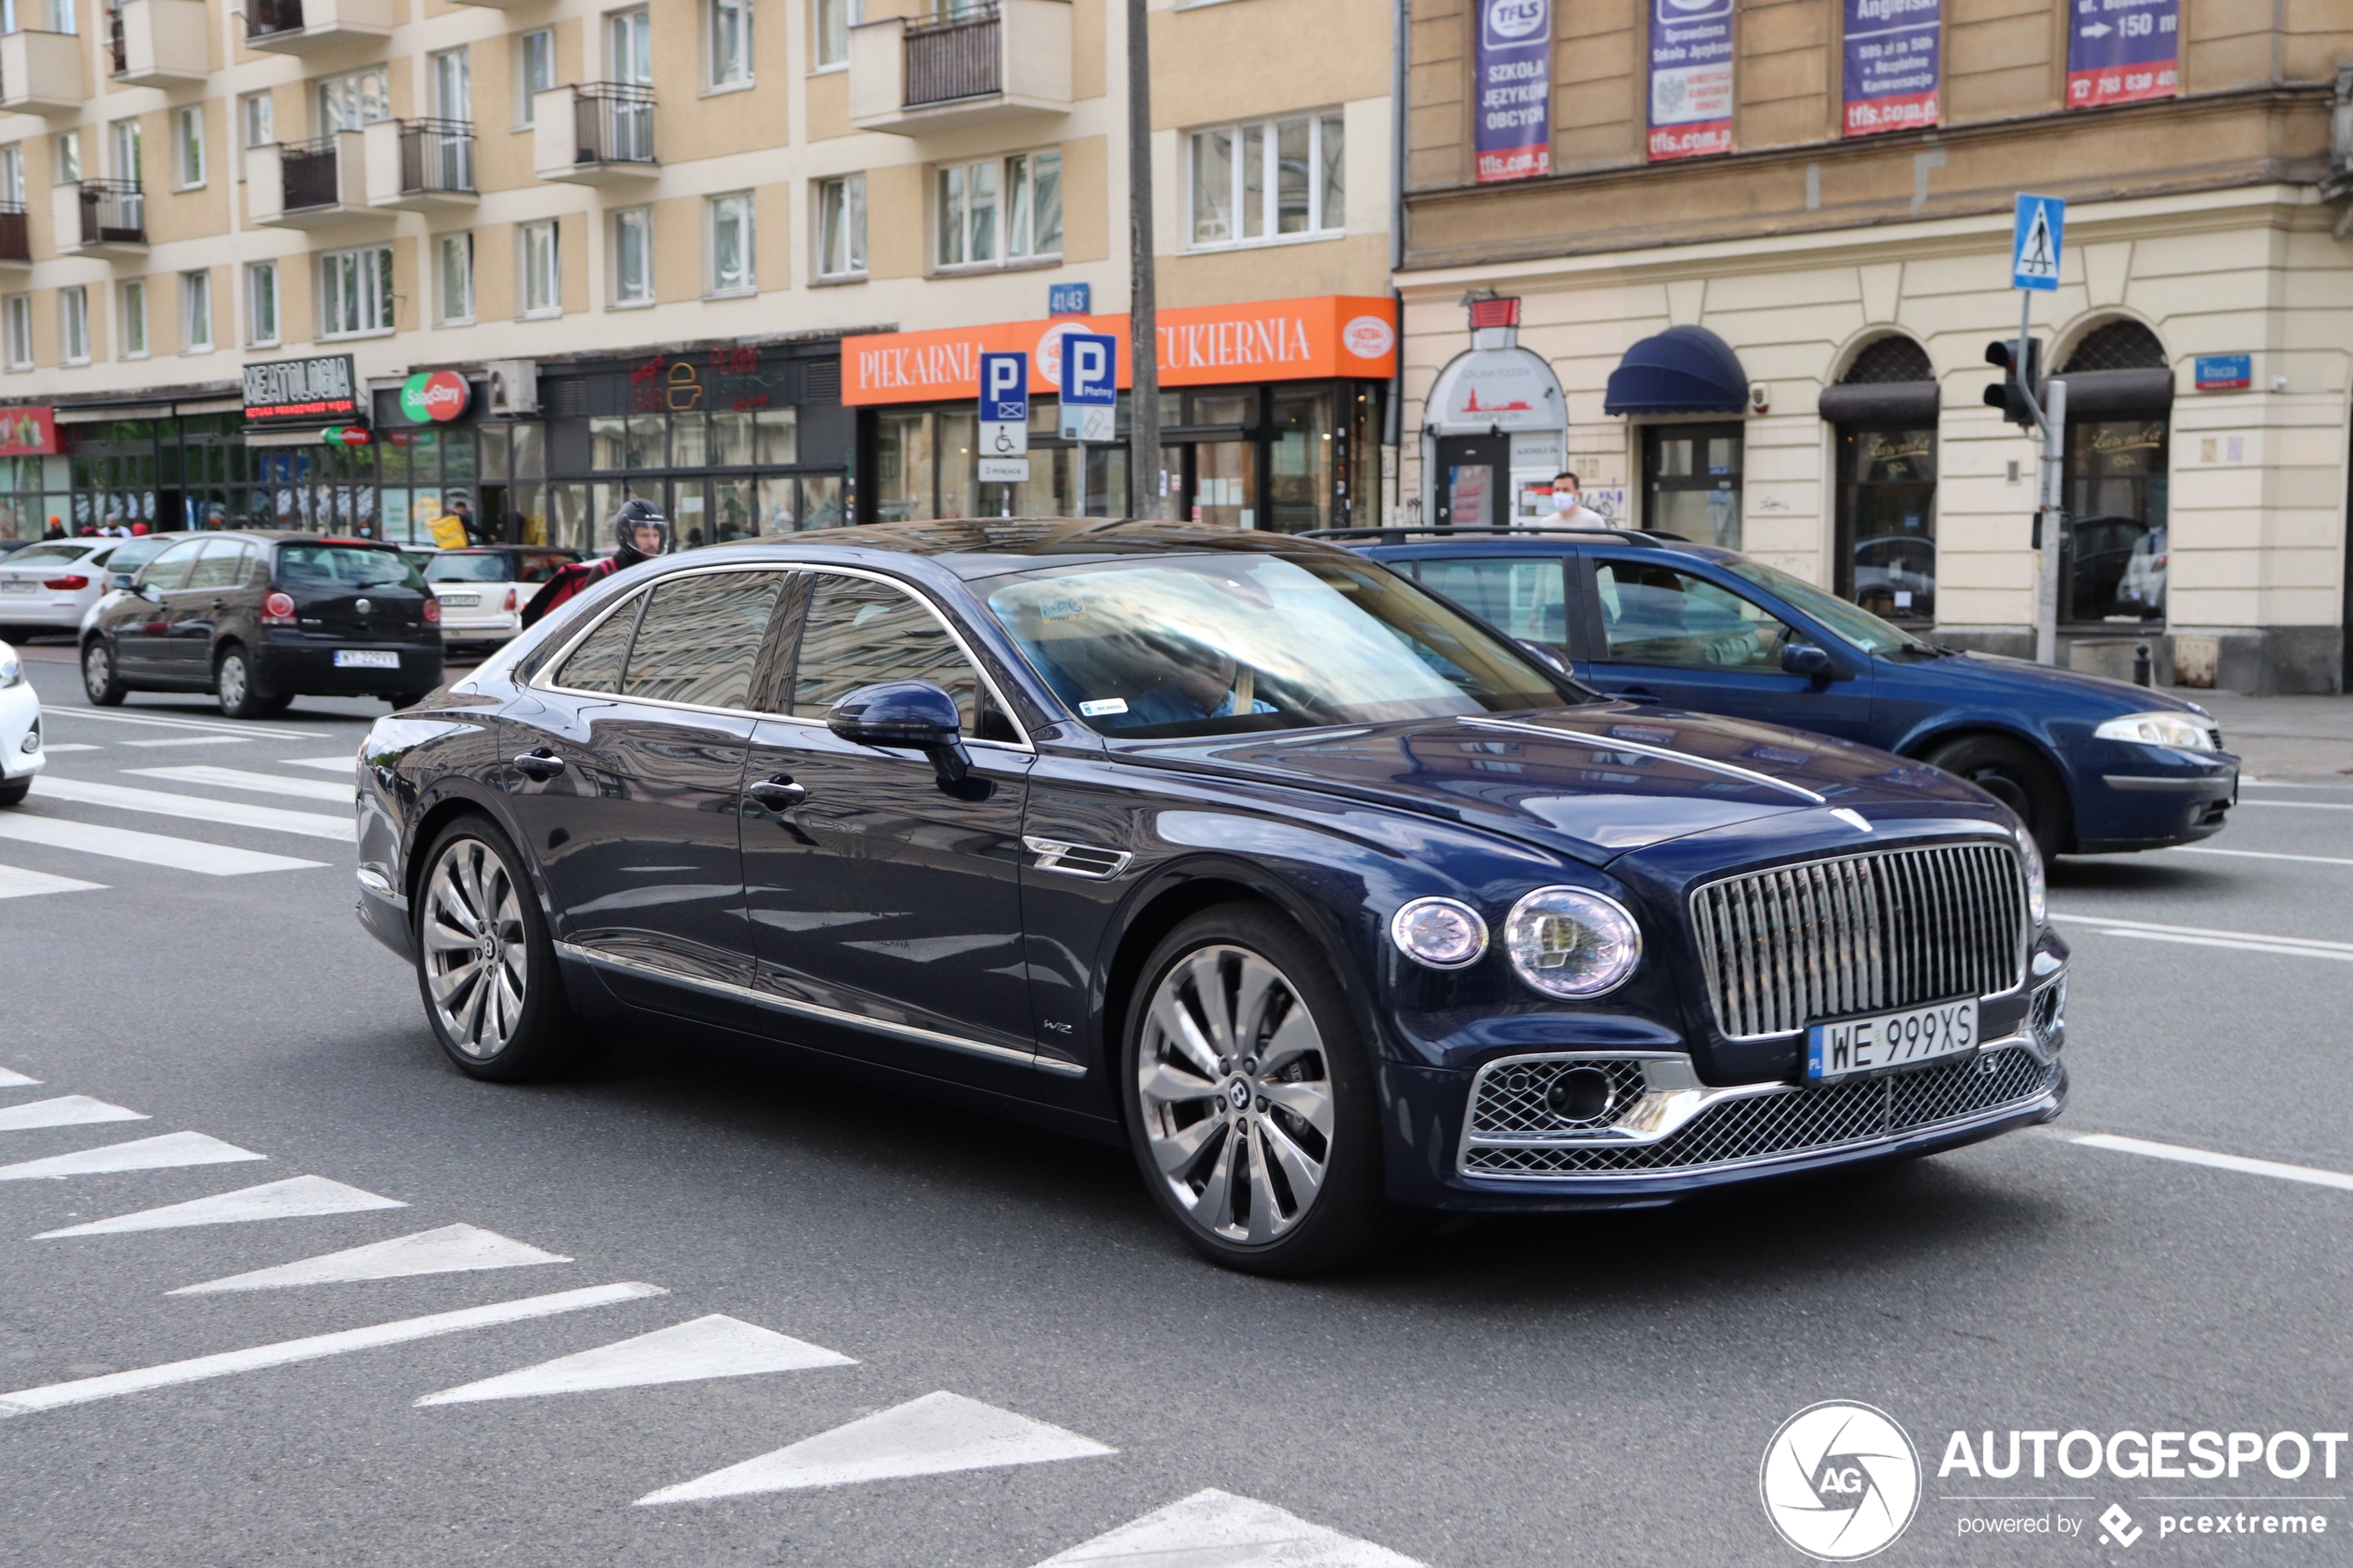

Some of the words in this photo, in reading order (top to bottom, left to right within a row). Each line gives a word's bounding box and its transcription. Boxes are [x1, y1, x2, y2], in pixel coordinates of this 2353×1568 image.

[1498, 2, 1539, 22] TFLS
[2118, 13, 2154, 38] 150
[2159, 14, 2178, 32] m
[1488, 59, 1544, 83] SZKOŁA
[1486, 106, 1544, 130] OBCYCH
[989, 358, 1018, 402] P
[1074, 341, 1106, 396] P
[243, 357, 351, 407] MEATOLOGIA
[1084, 385, 1114, 400] Płatny
[407, 383, 460, 406] SaladStory
[1831, 1022, 1873, 1071] WE
[1885, 1004, 1972, 1062] 999XS
[1809, 1057, 1822, 1071] PL
